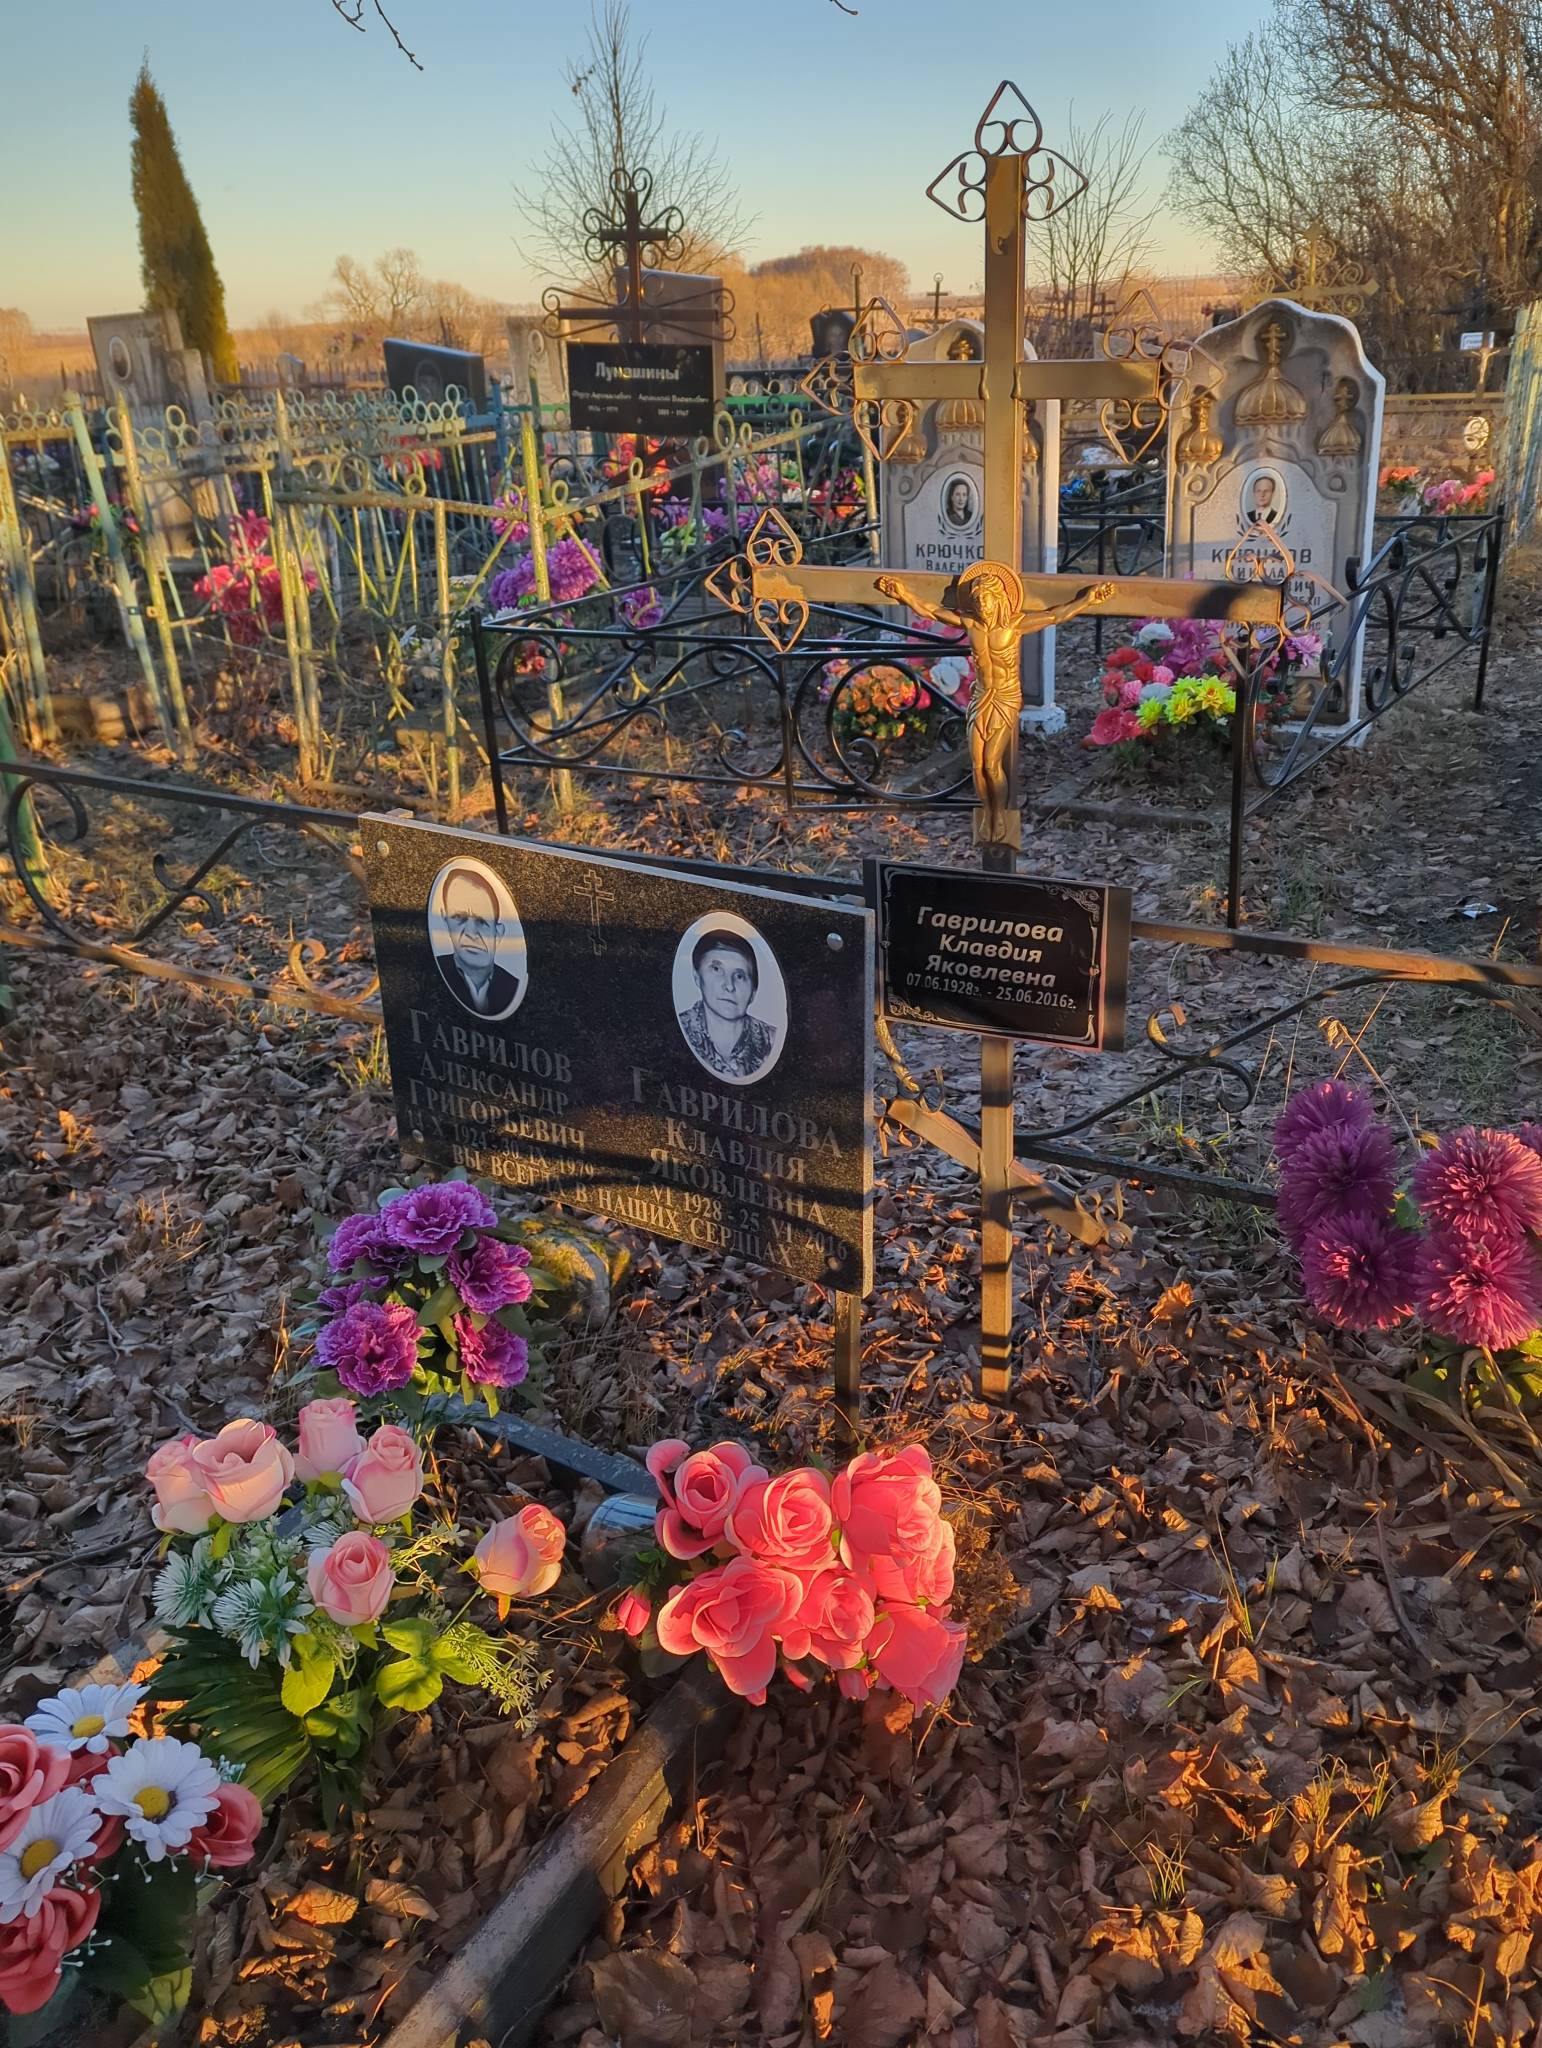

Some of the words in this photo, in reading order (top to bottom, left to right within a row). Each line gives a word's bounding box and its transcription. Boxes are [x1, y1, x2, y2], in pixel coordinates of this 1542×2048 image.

[916, 543, 985, 560] КРЮЧКО
[916, 905, 1064, 943] Гаврилова
[939, 933, 1043, 964] Клавдия
[924, 954, 1057, 988] Яковлевна
[995, 985, 1077, 1011] 25.06.2016г.
[408, 1008, 573, 1083] ГАВРИЛОВ
[409, 1078, 586, 1152] ГРИГОРЬЕВИЧ
[420, 1051, 569, 1116] АЛЕКСАНДР
[630, 1065, 843, 1159] ГАВРИЛОВА
[665, 1116, 806, 1185] КЛАВДИЯ
[452, 1143, 483, 1172] ВЫ
[575, 1181, 588, 1203] В
[598, 1187, 682, 1233] НАШИХ
[690, 1217, 794, 1268] СЕРДЦАХ
[648, 1147, 827, 1227] ЯКОВЛЕВНА
[684, 1191, 722, 1222] 1928
[739, 1207, 760, 1233] 25
[805, 1227, 849, 1262] 2016
